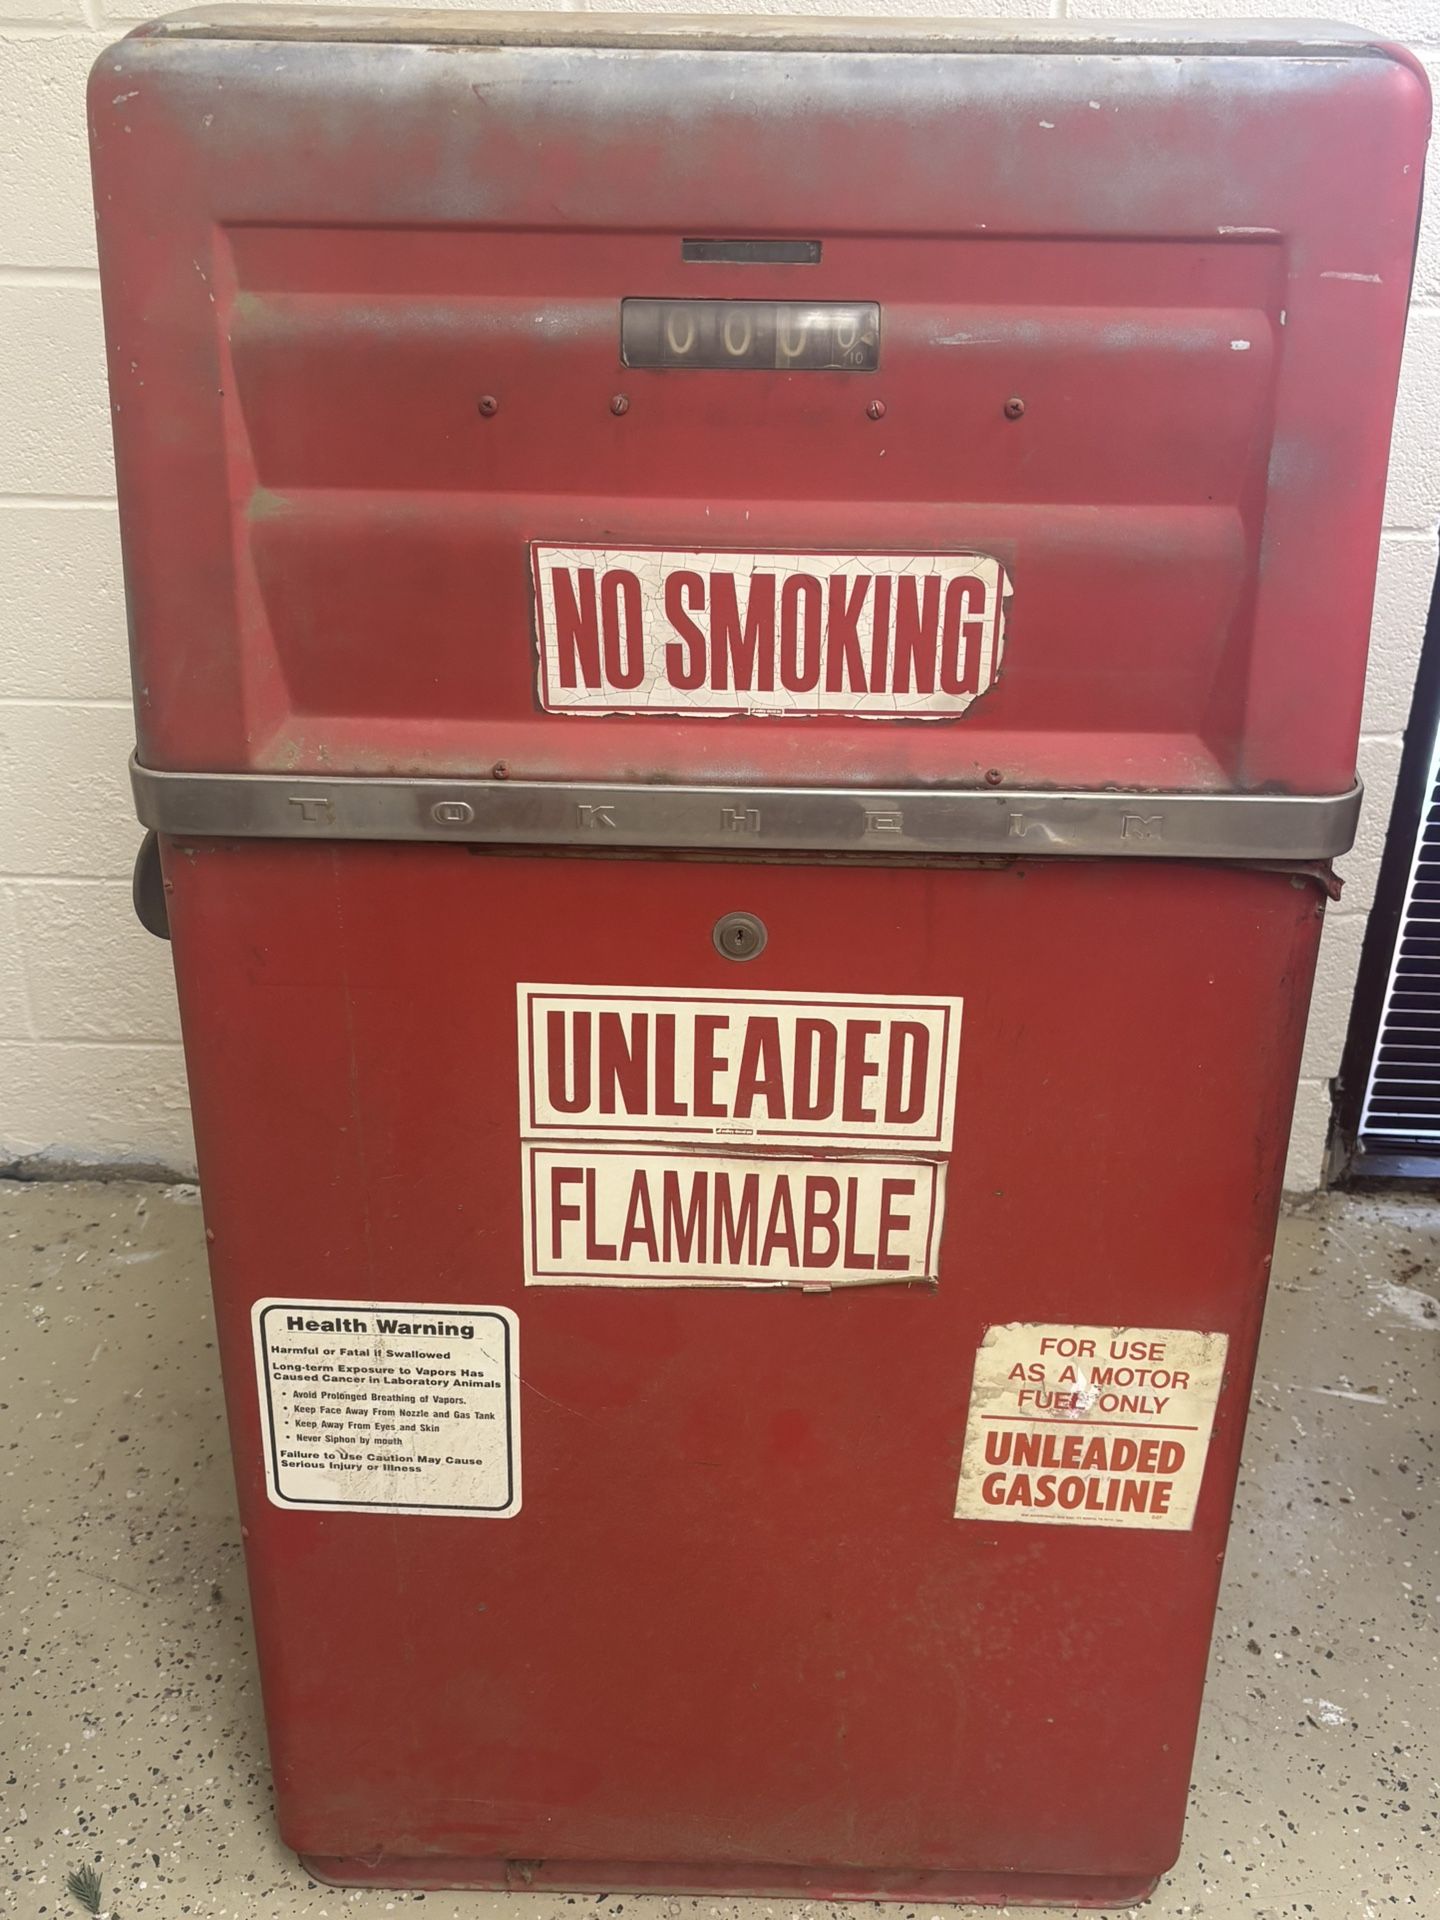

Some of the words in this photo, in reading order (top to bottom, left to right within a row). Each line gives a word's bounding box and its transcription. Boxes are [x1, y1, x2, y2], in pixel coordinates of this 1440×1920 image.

[550, 567, 645, 690] NO
[664, 570, 986, 695] SMOKING
[547, 1010, 930, 1125] UNLEADED
[551, 1166, 916, 1271] FLAMMABLE
[287, 1316, 367, 1333] Health
[377, 1319, 475, 1340] Warning
[271, 1346, 319, 1355] Harmful
[340, 1348, 370, 1357] Fatal
[374, 1349, 382, 1357] if
[386, 1349, 451, 1359] Swallowed
[1040, 1337, 1096, 1358] FOR
[1110, 1341, 1167, 1361] USE
[272, 1362, 334, 1372] Long-term
[338, 1365, 395, 1375] Exposure
[399, 1367, 411, 1375] to
[416, 1367, 457, 1377] Vapors
[461, 1369, 484, 1377] Has
[1008, 1362, 1045, 1382] AS
[1058, 1365, 1077, 1383] A
[1090, 1366, 1190, 1389] MOTOR
[273, 1372, 319, 1382] Caused
[322, 1374, 366, 1383] Cancer
[369, 1376, 380, 1384] in
[384, 1377, 450, 1388] Laboratory
[453, 1379, 501, 1388] Animals
[293, 1390, 317, 1399] Avoid
[321, 1391, 367, 1401] Prolonged
[371, 1393, 416, 1404] Breathing
[420, 1395, 429, 1403] of
[433, 1395, 466, 1405] Vapors.
[1018, 1389, 1086, 1410] FUEL
[1099, 1393, 1170, 1414] ONLY
[294, 1405, 316, 1415] Keep
[320, 1406, 341, 1415] Face
[345, 1407, 369, 1417] Away
[372, 1408, 396, 1416] From
[399, 1409, 429, 1418] Nozzle
[454, 1411, 471, 1419] Gas
[475, 1411, 496, 1420] Tank
[295, 1420, 317, 1429] Keep
[321, 1420, 344, 1430] Away
[348, 1421, 371, 1430] From
[374, 1422, 396, 1432] Eyes
[420, 1424, 440, 1432] Skin
[296, 1434, 321, 1442] Never
[325, 1434, 356, 1444] Siphon
[360, 1436, 370, 1445] by
[374, 1437, 403, 1445] mouth
[280, 1450, 320, 1459] Failure
[324, 1452, 336, 1460] to
[340, 1453, 362, 1461] Use
[367, 1453, 413, 1463] Caution
[417, 1456, 441, 1465] May
[445, 1456, 483, 1465] Cause
[984, 1431, 1186, 1475] UNLEADED
[281, 1460, 325, 1469] Serious
[329, 1462, 362, 1472] Injury
[383, 1464, 422, 1473] Illness
[981, 1472, 1173, 1514] GASOLINE
